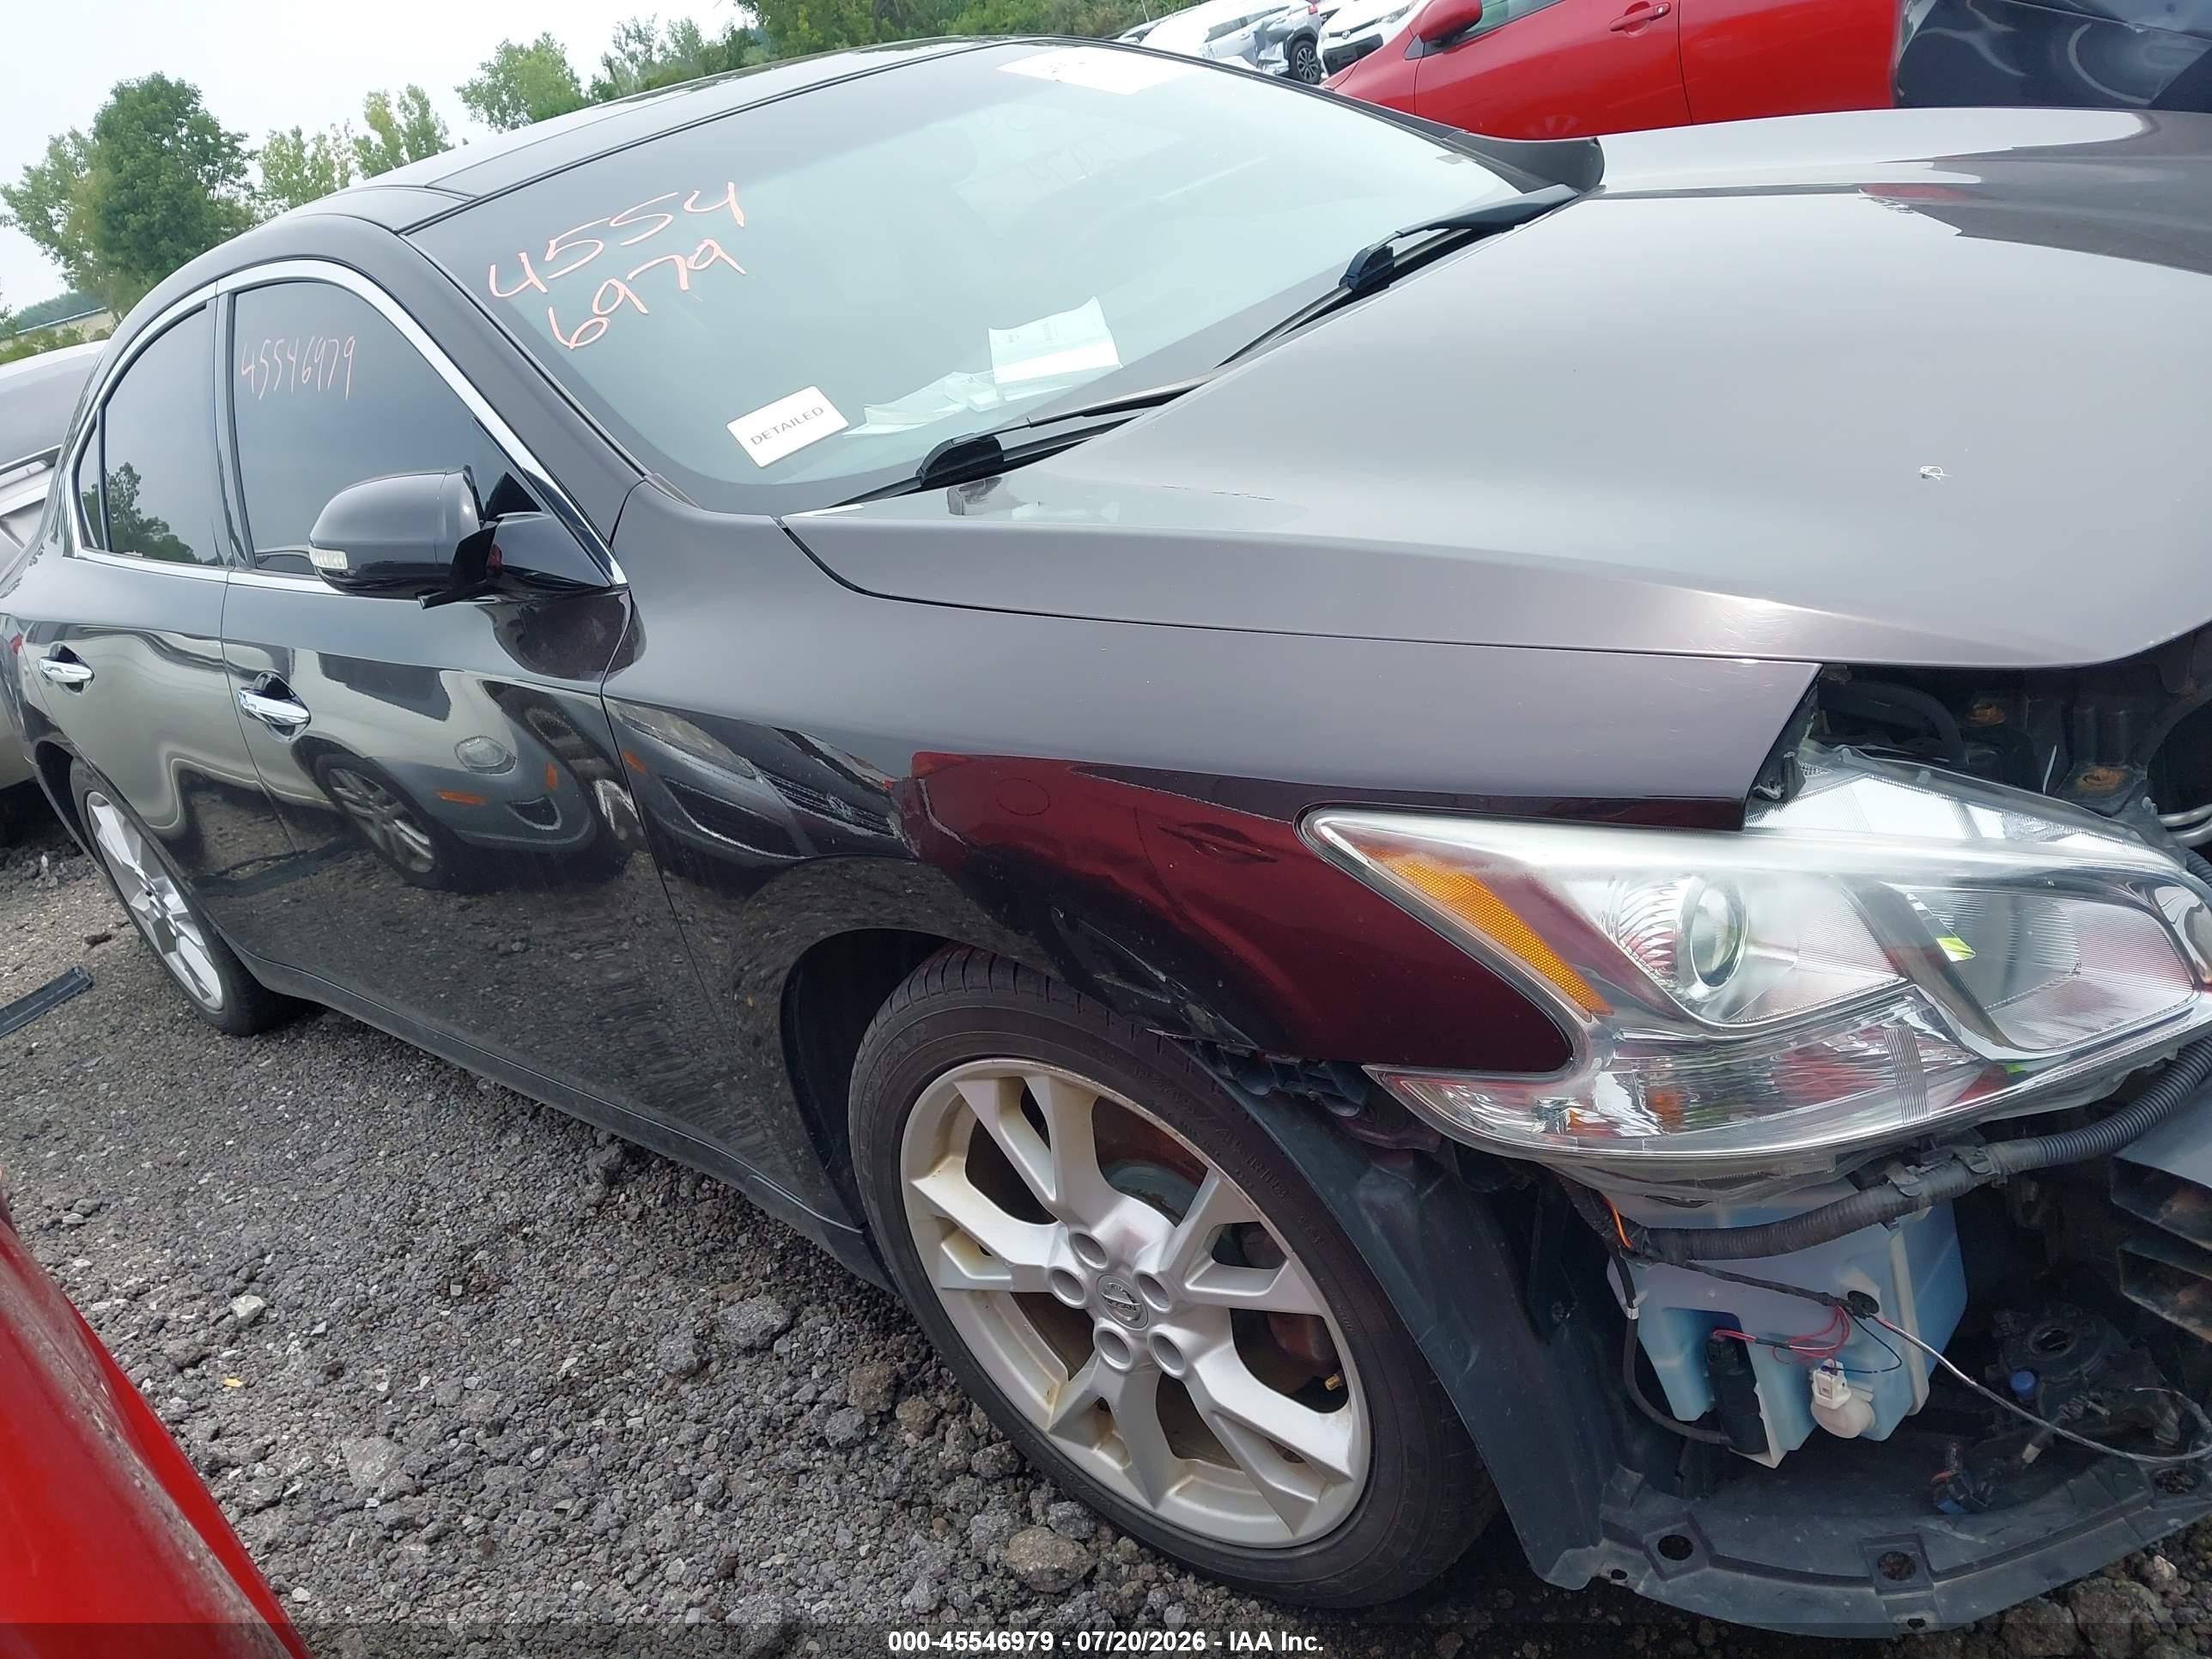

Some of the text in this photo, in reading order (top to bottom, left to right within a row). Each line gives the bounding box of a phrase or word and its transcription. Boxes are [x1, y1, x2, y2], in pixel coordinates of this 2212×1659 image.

[488, 180, 745, 298] 4554
[548, 238, 747, 349] 6979
[240, 335, 356, 400] 45546979
[750, 406, 824, 446] DETAILED
